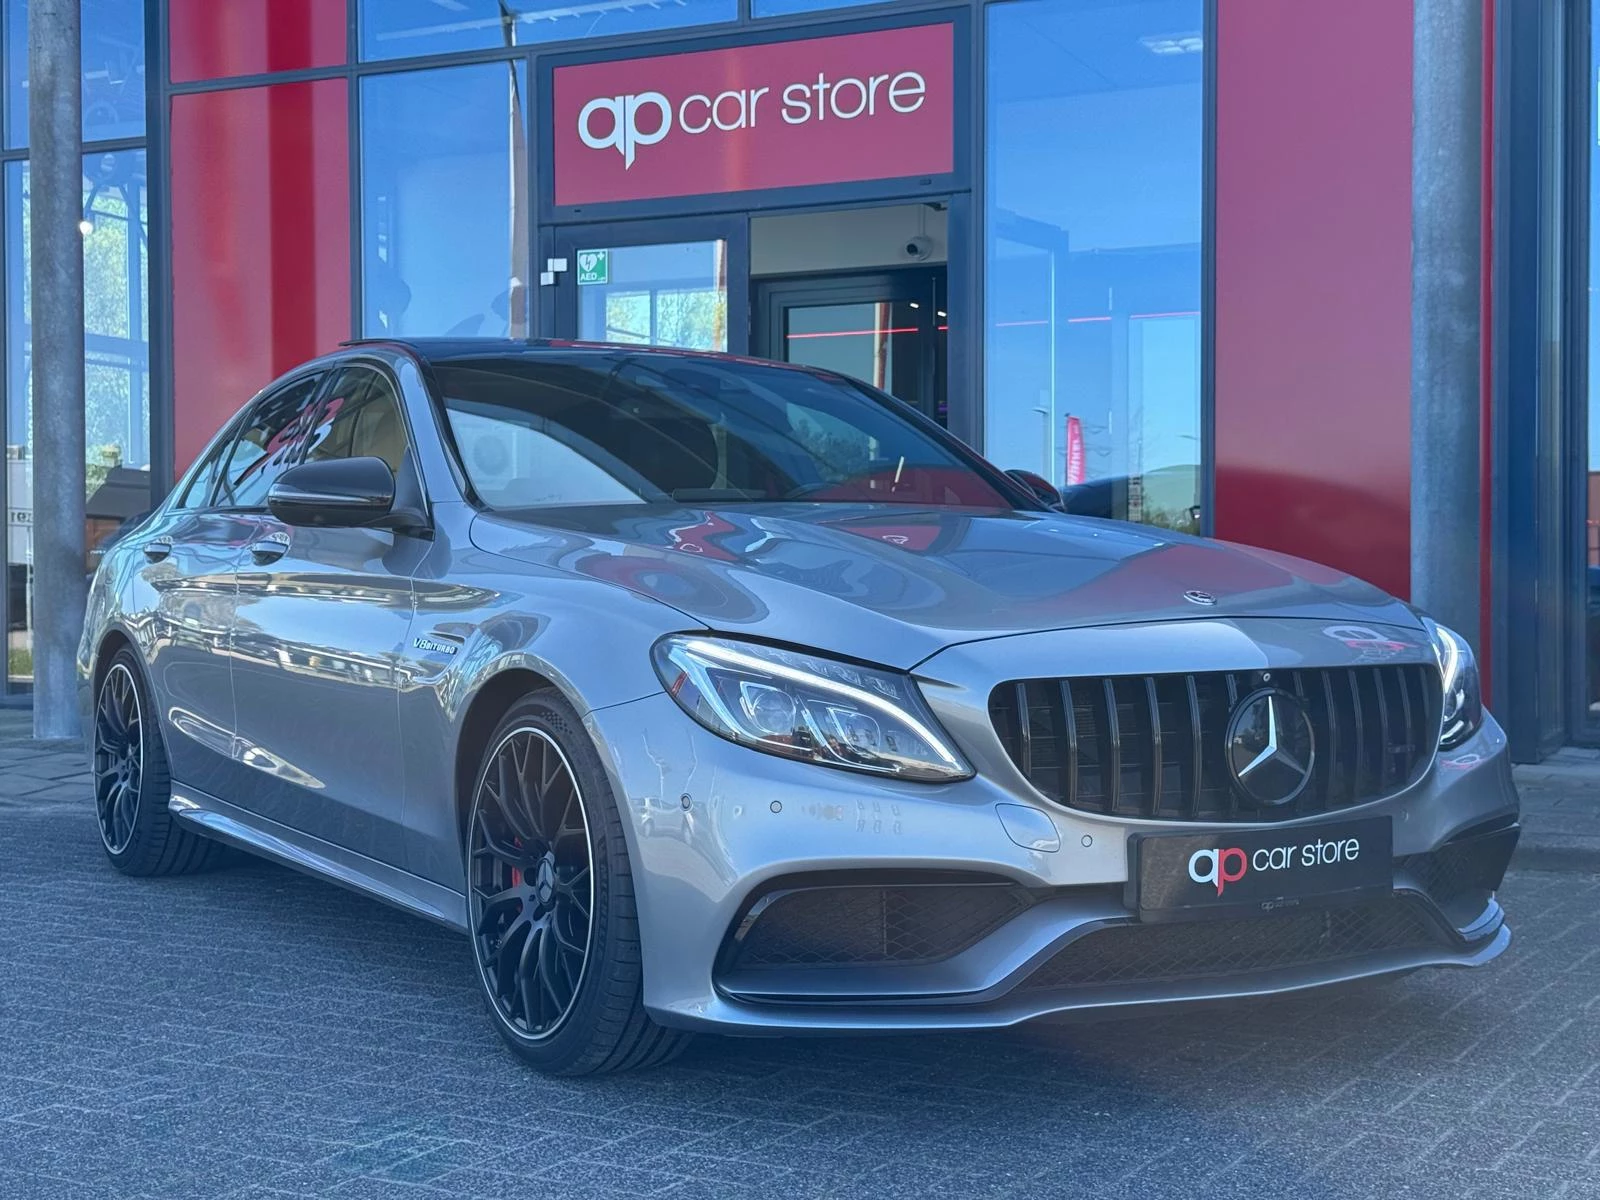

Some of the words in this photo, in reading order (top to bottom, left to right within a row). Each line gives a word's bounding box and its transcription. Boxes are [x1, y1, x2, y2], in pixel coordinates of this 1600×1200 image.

[577, 91, 673, 171] ap
[679, 87, 770, 134] car
[781, 71, 926, 124] store
[580, 272, 598, 281] AED
[1188, 847, 1248, 897] ap
[1252, 845, 1297, 872] car
[1301, 838, 1360, 867] store
